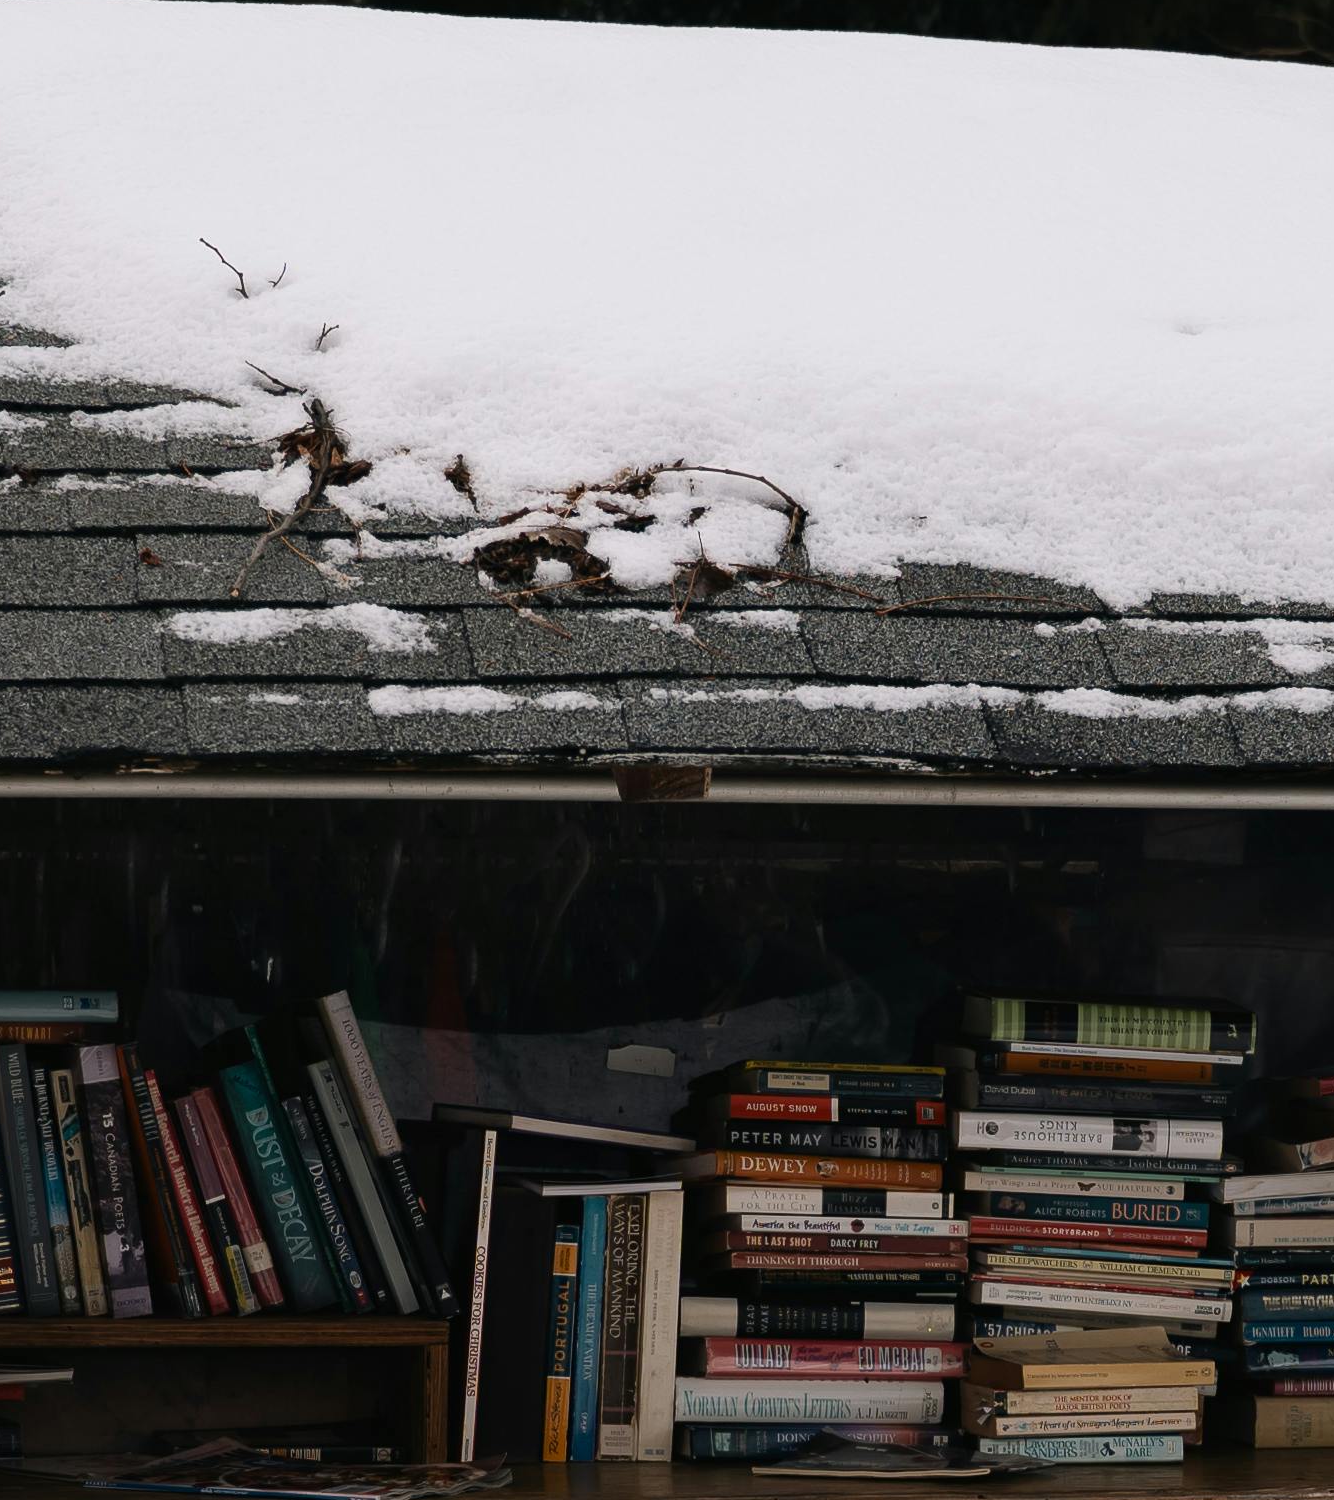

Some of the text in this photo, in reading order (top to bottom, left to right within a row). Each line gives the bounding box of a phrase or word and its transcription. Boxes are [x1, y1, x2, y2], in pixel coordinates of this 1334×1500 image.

[7, 1027, 52, 1040] STEWART
[984, 1085, 1036, 1095] David Dubal
[746, 1102, 817, 1114] AUGUST SNOW
[1040, 1120, 1077, 1130] KINGS
[731, 1131, 822, 1147] PETER MAY
[831, 1134, 916, 1151] LEWIS MAN
[1013, 1130, 1103, 1144] BARRELHOUSE
[740, 1155, 808, 1175] DEWEY
[1012, 1156, 1089, 1166] Audrey THOMAS
[1128, 1159, 1198, 1171] Isobel Gunn
[246, 1104, 317, 1263] DUST & DECAY
[307, 1161, 356, 1263] DOLPHIN SONG
[1034, 1206, 1107, 1218] ALICE ROBERTS
[1111, 1202, 1181, 1222] BURIED
[752, 1220, 841, 1232] America the Beautiful
[746, 1235, 812, 1248] THE LAST SHOT
[830, 1238, 879, 1250] DARCY FREY
[623, 1204, 639, 1324] EXPLORING THE
[988, 1255, 1078, 1268] THE SLEEPWATCHERS
[608, 1203, 625, 1338] WAYS OF MANKIND
[1260, 1276, 1296, 1285] DOBSON
[465, 1245, 487, 1397] COOKIES FOR CHRISTMAS
[746, 1303, 755, 1334] DEAD
[759, 1303, 769, 1336] WAKE
[554, 1280, 570, 1372] PORTUGAL
[1252, 1326, 1295, 1338] IGNATIEFF
[1303, 1326, 1332, 1337] BLOOD
[735, 1343, 792, 1370] LULLABY
[683, 1390, 852, 1420] NORMAN CORWIN'S LETTERS
[1024, 1440, 1077, 1449] Lawrence
[1025, 1448, 1077, 1458] SANDERS
[1126, 1447, 1152, 1457] DARE
